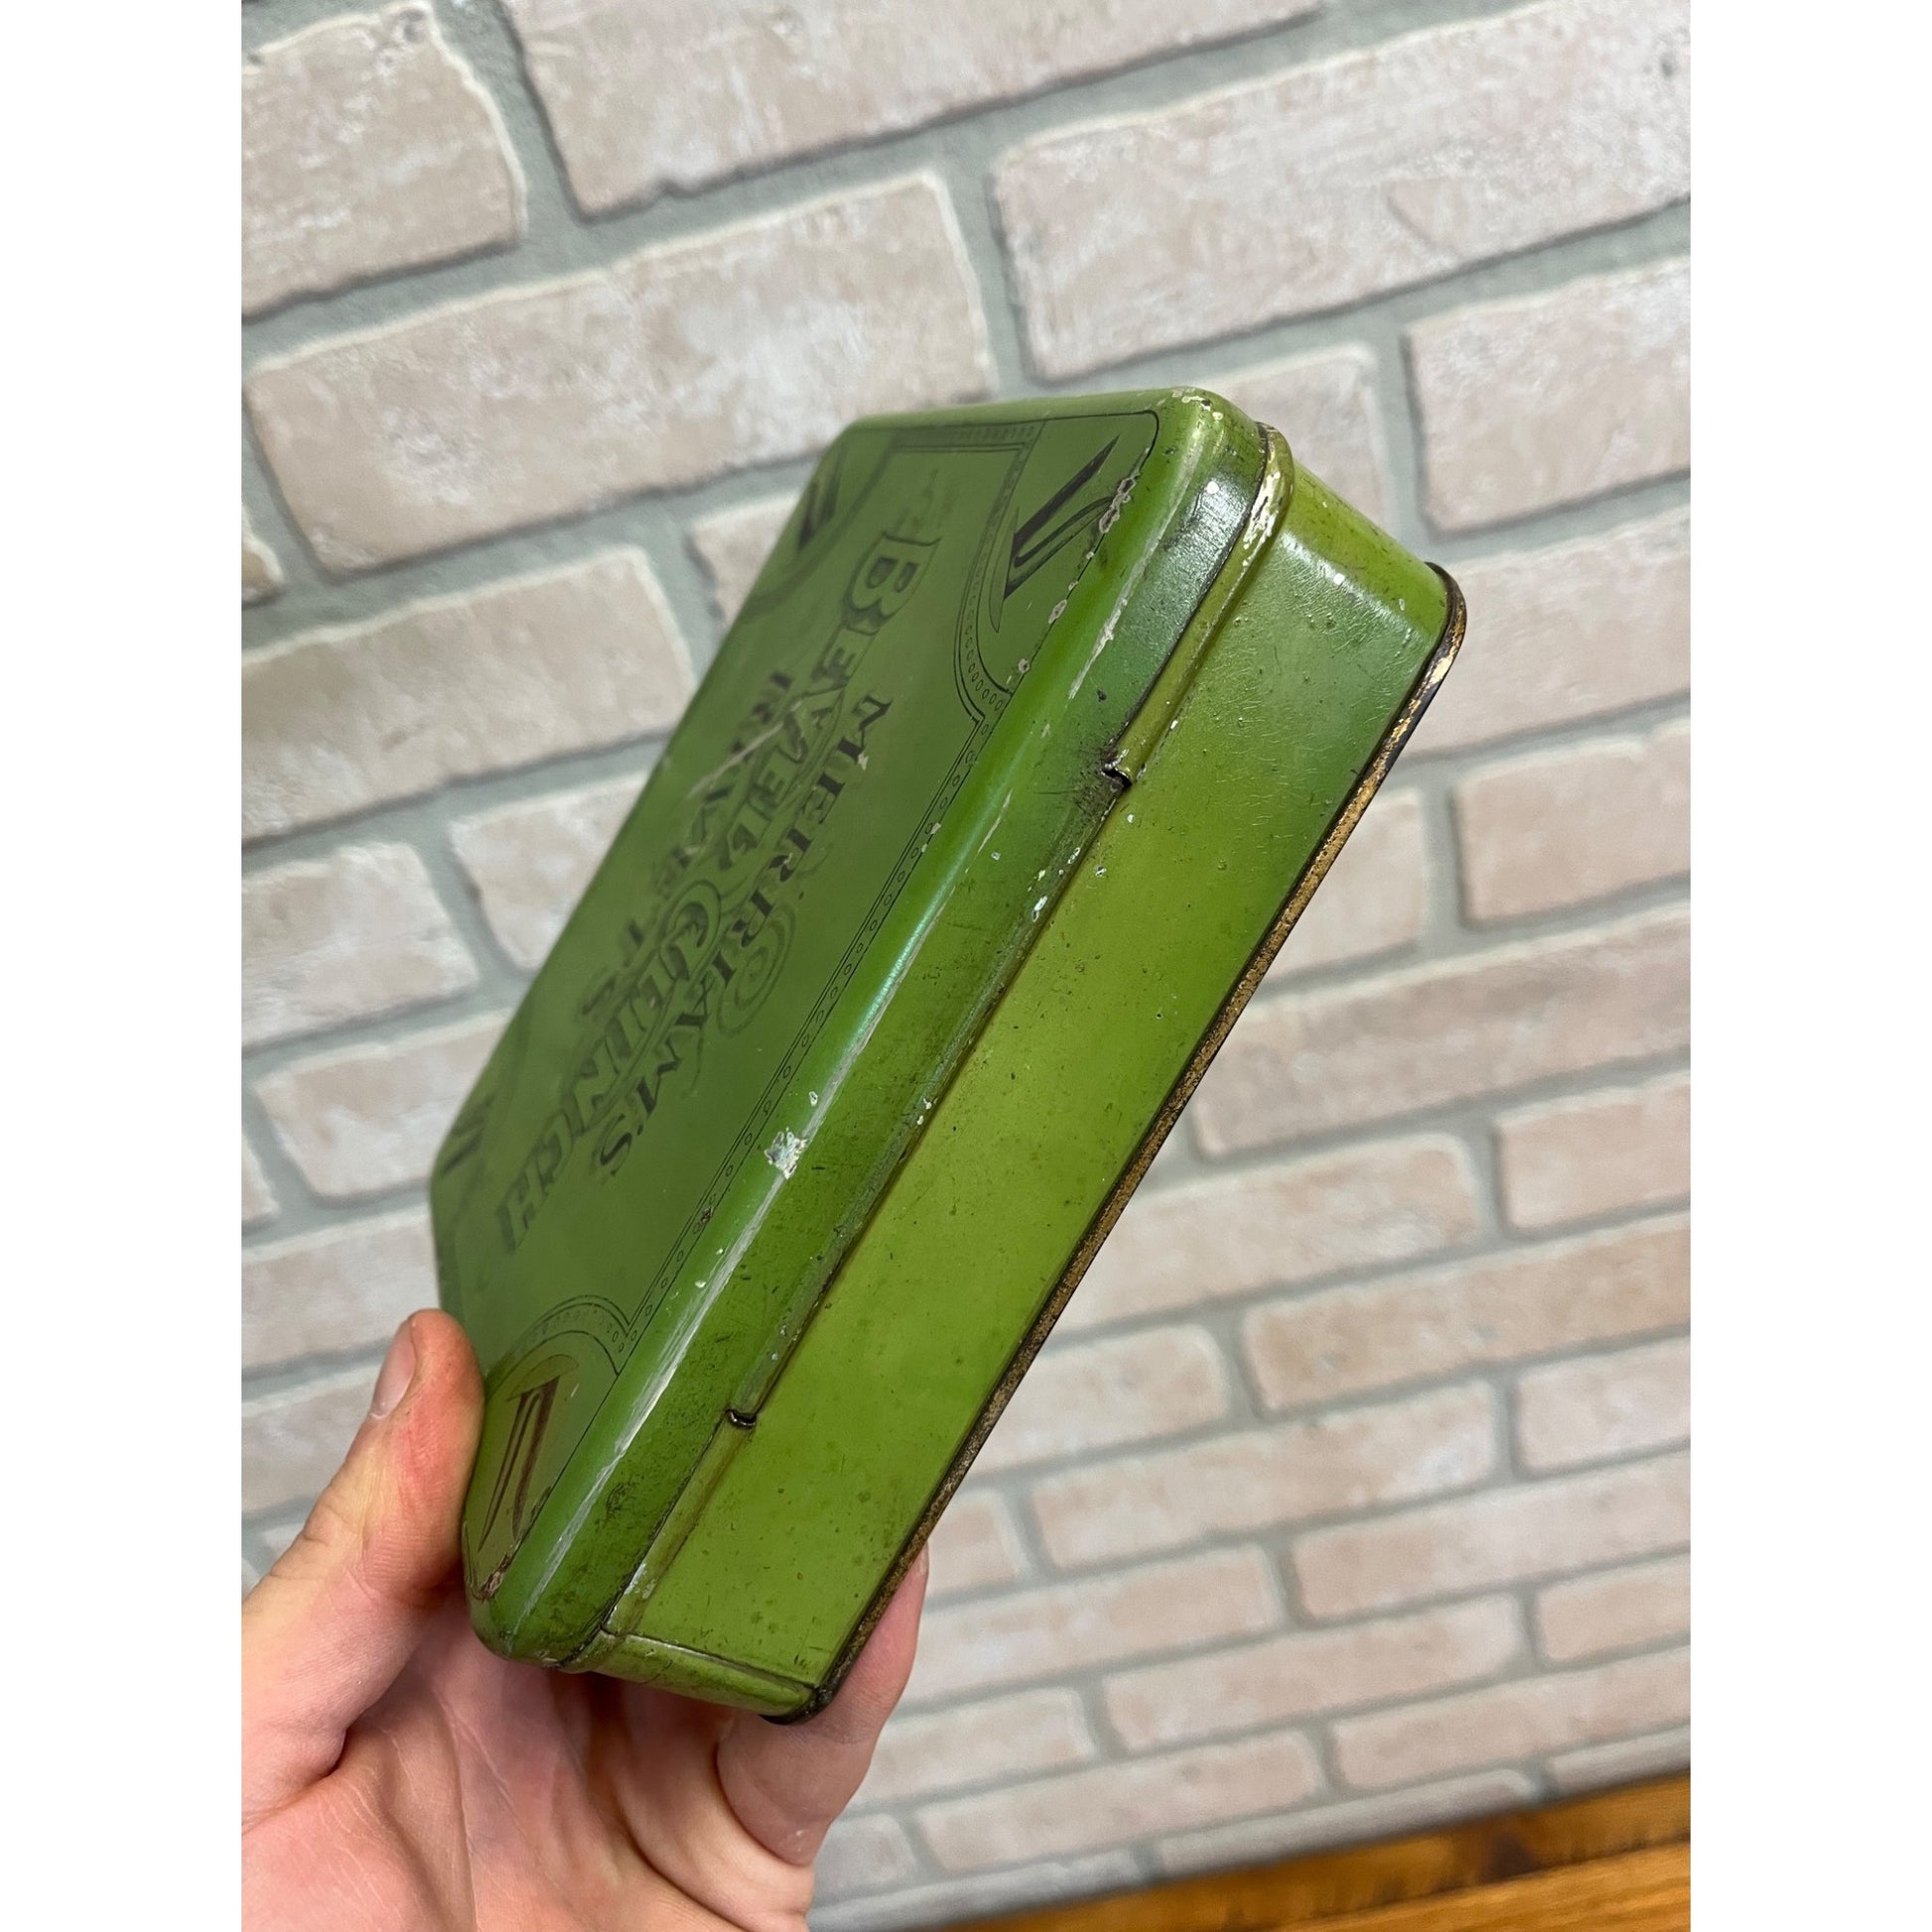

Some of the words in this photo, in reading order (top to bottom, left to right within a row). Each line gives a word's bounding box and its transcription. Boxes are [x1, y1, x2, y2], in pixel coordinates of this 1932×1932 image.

[723, 531, 944, 862] BEVEL
[496, 880, 722, 1257] CLINCH
[595, 694, 893, 1181] MERRIAM'S
